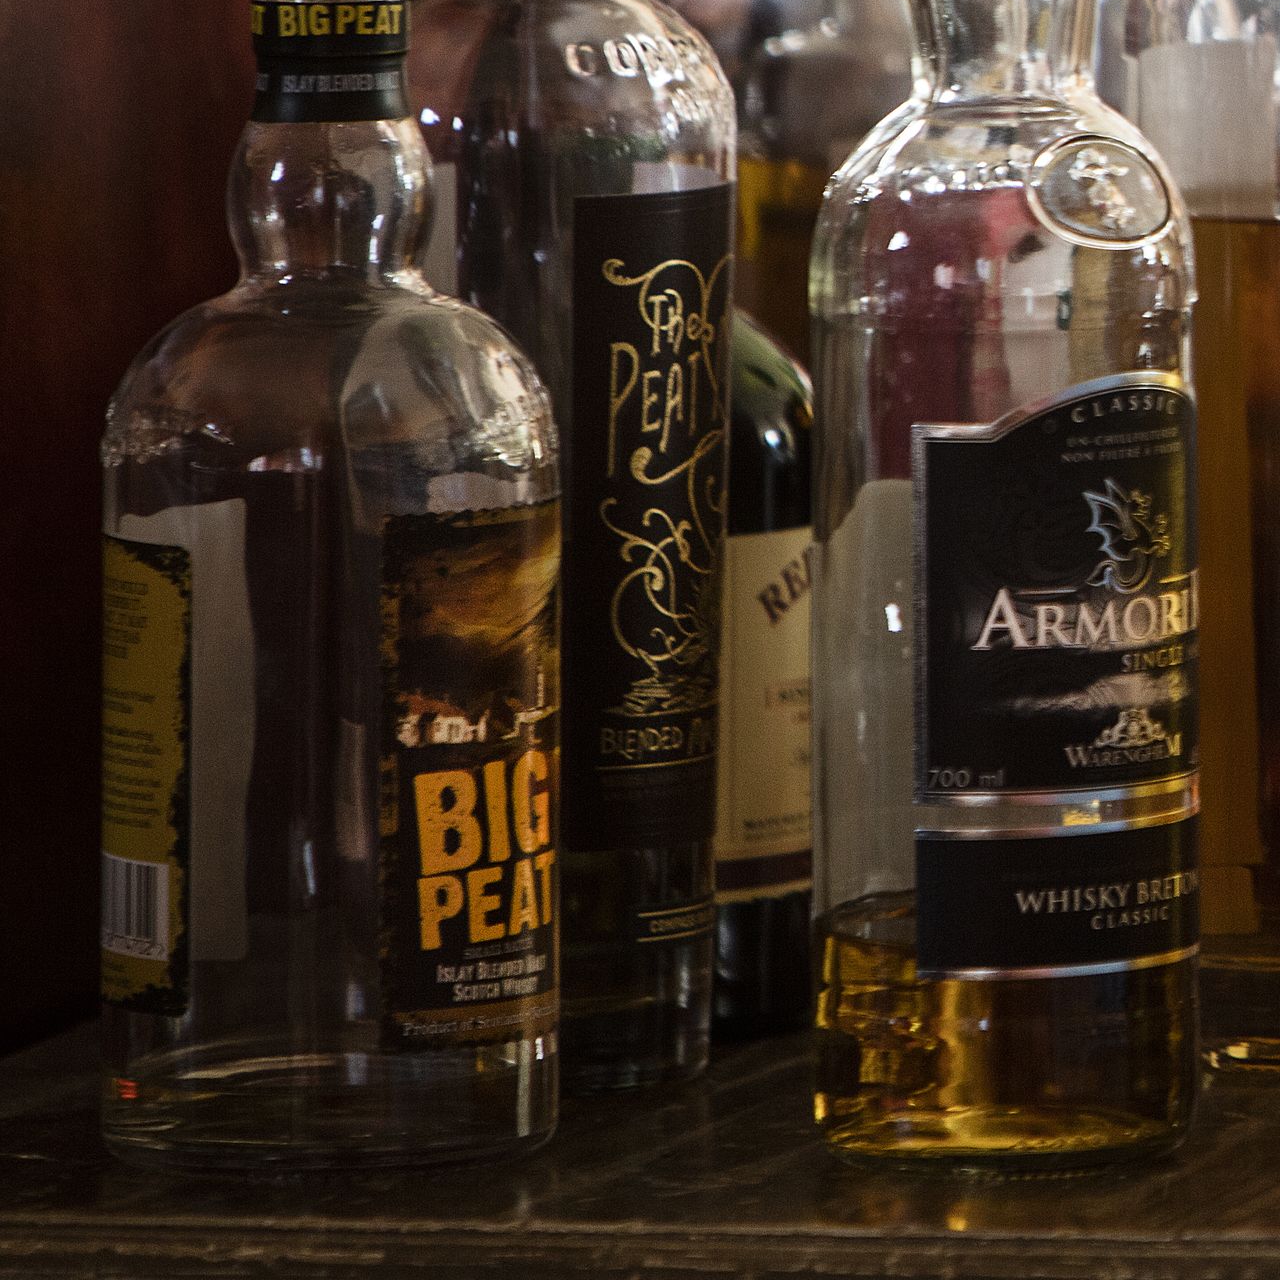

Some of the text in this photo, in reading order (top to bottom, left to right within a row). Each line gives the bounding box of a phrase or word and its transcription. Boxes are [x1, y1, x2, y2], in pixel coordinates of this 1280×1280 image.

[278, 4, 331, 37] BIG
[335, 4, 403, 35] PEAT
[1071, 395, 1178, 423] CLASSIC
[927, 770, 1004, 789] 700 ml
[414, 751, 550, 876] BIG
[417, 849, 556, 950] PEAT
[1015, 882, 1130, 915] WHISKY
[1090, 905, 1170, 931] CLASSIC
